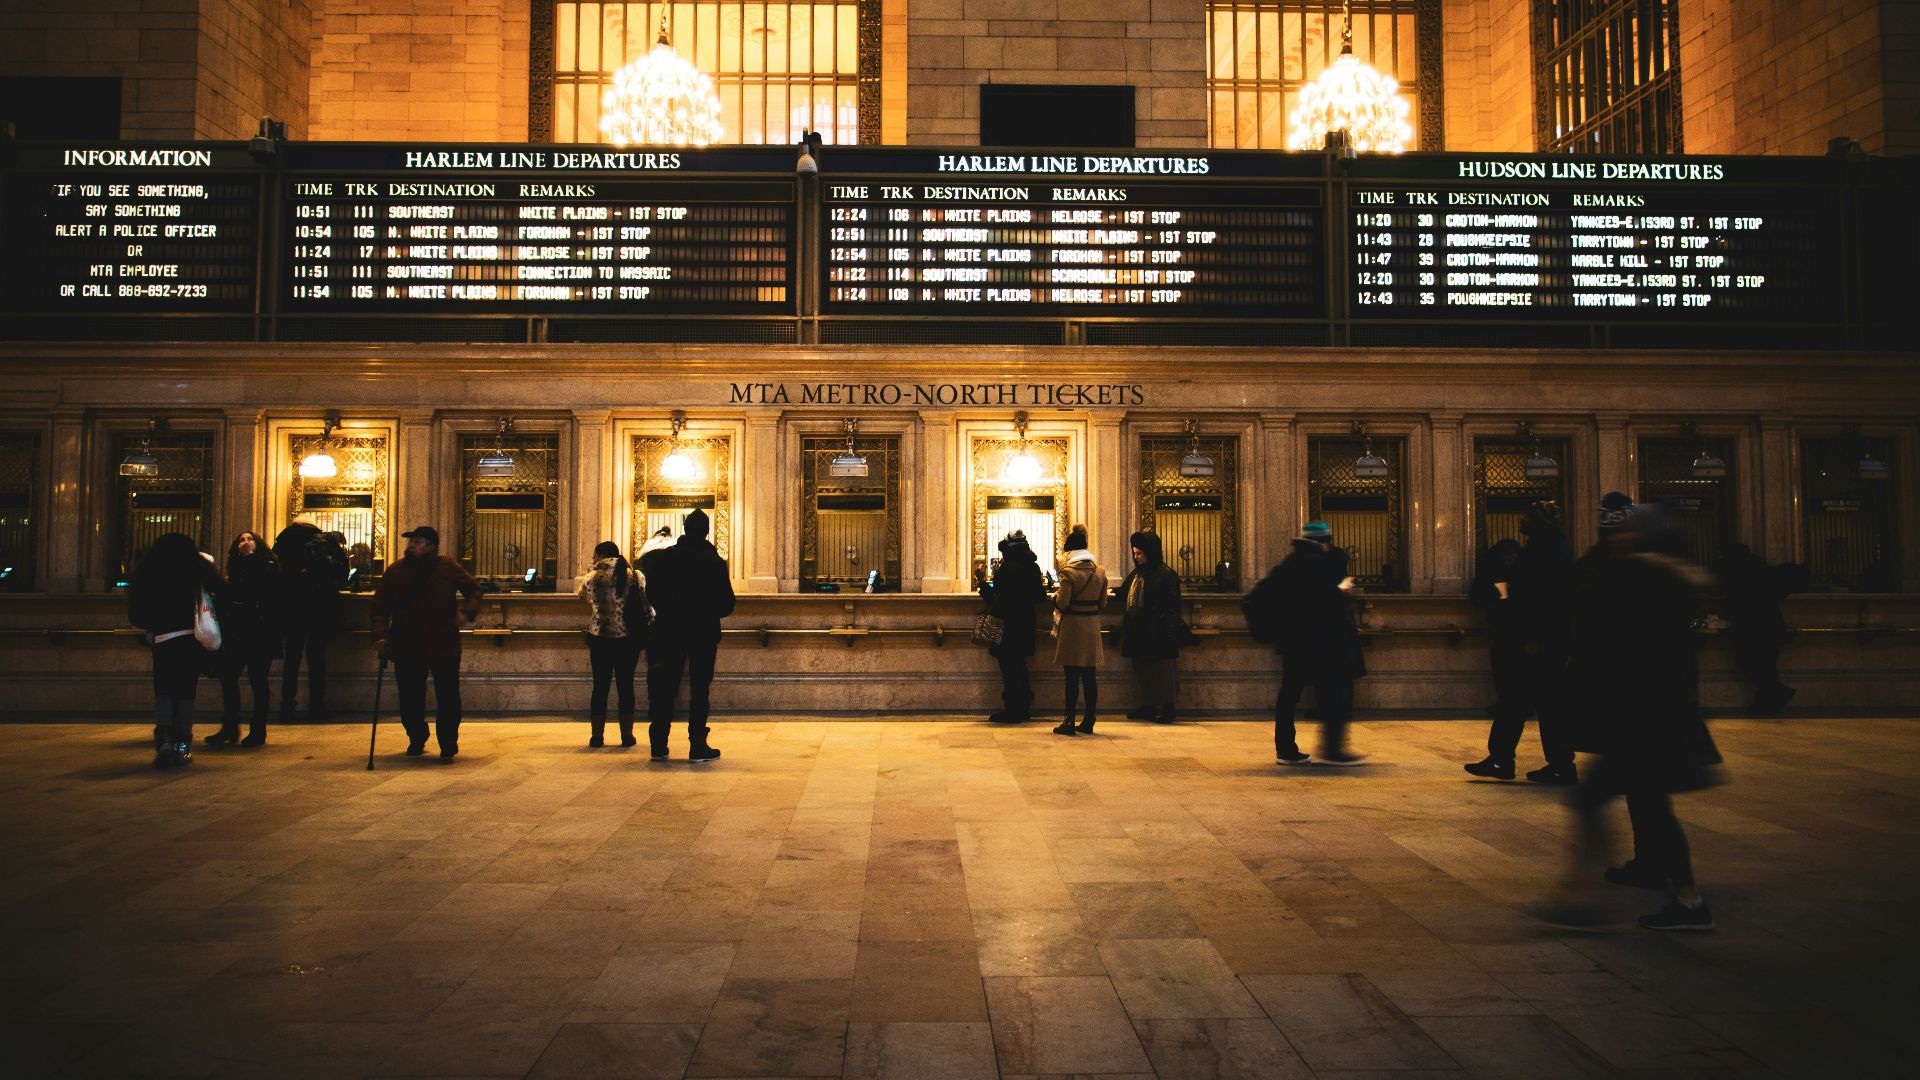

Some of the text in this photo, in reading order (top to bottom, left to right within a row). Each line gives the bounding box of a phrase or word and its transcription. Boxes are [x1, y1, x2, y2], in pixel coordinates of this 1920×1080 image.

[64, 150, 211, 167] INFORMATION
[405, 151, 681, 169] HARLEM LINE DEPARTURES
[938, 155, 1210, 174] HARLEM LINE DEPARTURES
[1459, 161, 1724, 180] HUDSON LINE DEPARTURES
[57, 184, 209, 199] IF YOU SEE SOMETHING,
[295, 183, 595, 197] TIME TRK DESTINATION REMARKS
[831, 186, 1127, 201] TIME TRK DESTINATION REMARKS
[1357, 191, 1645, 207] TIME TRK DESTINATION REMARKS
[85, 204, 181, 217] SAY SOMETHING
[296, 205, 688, 220] 10:51 111 SOUTHEAST WHITE PLAINS 1ST STOP
[831, 208, 867, 222] 12:24
[922, 209, 937, 222] N.
[944, 209, 982, 222] WHITE
[986, 209, 1032, 223] PLAINS
[1051, 209, 1103, 224] MELROSE
[1124, 210, 1145, 224] 1ST
[1151, 211, 1181, 225] STOP
[1356, 213, 1392, 227] 11:20
[1417, 213, 1434, 227] 30
[1445, 213, 1539, 228] CROTON-HARMON
[1679, 216, 1700, 230] ST.
[1708, 216, 1729, 230] 1ST
[1734, 217, 1763, 230] STOP
[55, 224, 217, 238] ALERT A POLICE OFFICER
[295, 225, 651, 240] 10:54 105 N. WHITE PLAINS FORDHAM 1ST STOP
[830, 227, 1217, 245] 12:51 111 SOUTHEAST WHITE PLAINS 1ST STOP
[1356, 232, 1393, 246] 11:43
[1446, 233, 1531, 248] POUGHKEEPSIE
[1570, 234, 1635, 249] TARRYTOWN
[1654, 235, 1675, 249] 1ST
[1680, 235, 1710, 249] STOP
[127, 244, 143, 257] OR
[294, 245, 651, 261] 11:24 17 N. WHITE PLAINS MELROSE 1ST STOP
[830, 247, 1182, 264] 12:54 105 N. WHITE PLAINS FORDHAM 1ST STOP
[1357, 252, 1725, 268] 11:47 39 CROTON-HARMON MARBLE HILL 1ST STOP
[90, 264, 179, 277] MTA EMPLOYEE
[294, 265, 329, 278] 11:51
[352, 265, 372, 279] 111
[386, 265, 454, 279] SOUTHEAST
[517, 265, 593, 280] CONNECTION
[598, 266, 614, 280] TO
[837, 267, 867, 282] 1:22
[887, 267, 911, 281] 114
[922, 267, 990, 282] SOUTHEAST
[1137, 269, 1160, 284] 1ST
[1165, 269, 1196, 284] STOP
[1357, 272, 1393, 286] 12:20
[1419, 272, 1435, 286] 30
[1446, 272, 1540, 287] CROTON-HARMON
[1681, 274, 1702, 288] ST.
[1710, 275, 1731, 288] 1ST
[1736, 275, 1765, 288] STOP
[60, 284, 208, 298] OR CALL 888-692-7233
[293, 284, 650, 301] 11:54 105 N. WHITE PLAINS FORDHAM 1ST STOP
[837, 287, 868, 301] 1:24
[922, 288, 936, 301] N.
[944, 288, 982, 303] WHITE
[986, 288, 1033, 302] PLAINS
[1051, 288, 1103, 304] MELROSE
[1124, 289, 1145, 303] 1ST
[1151, 289, 1182, 303] STOP
[1358, 291, 1712, 307] 12:43 35 POUGHKEEPSIE TARRYTOWN 1ST STOP
[728, 383, 1144, 405] MTA METRO-NORTH TICKETS
